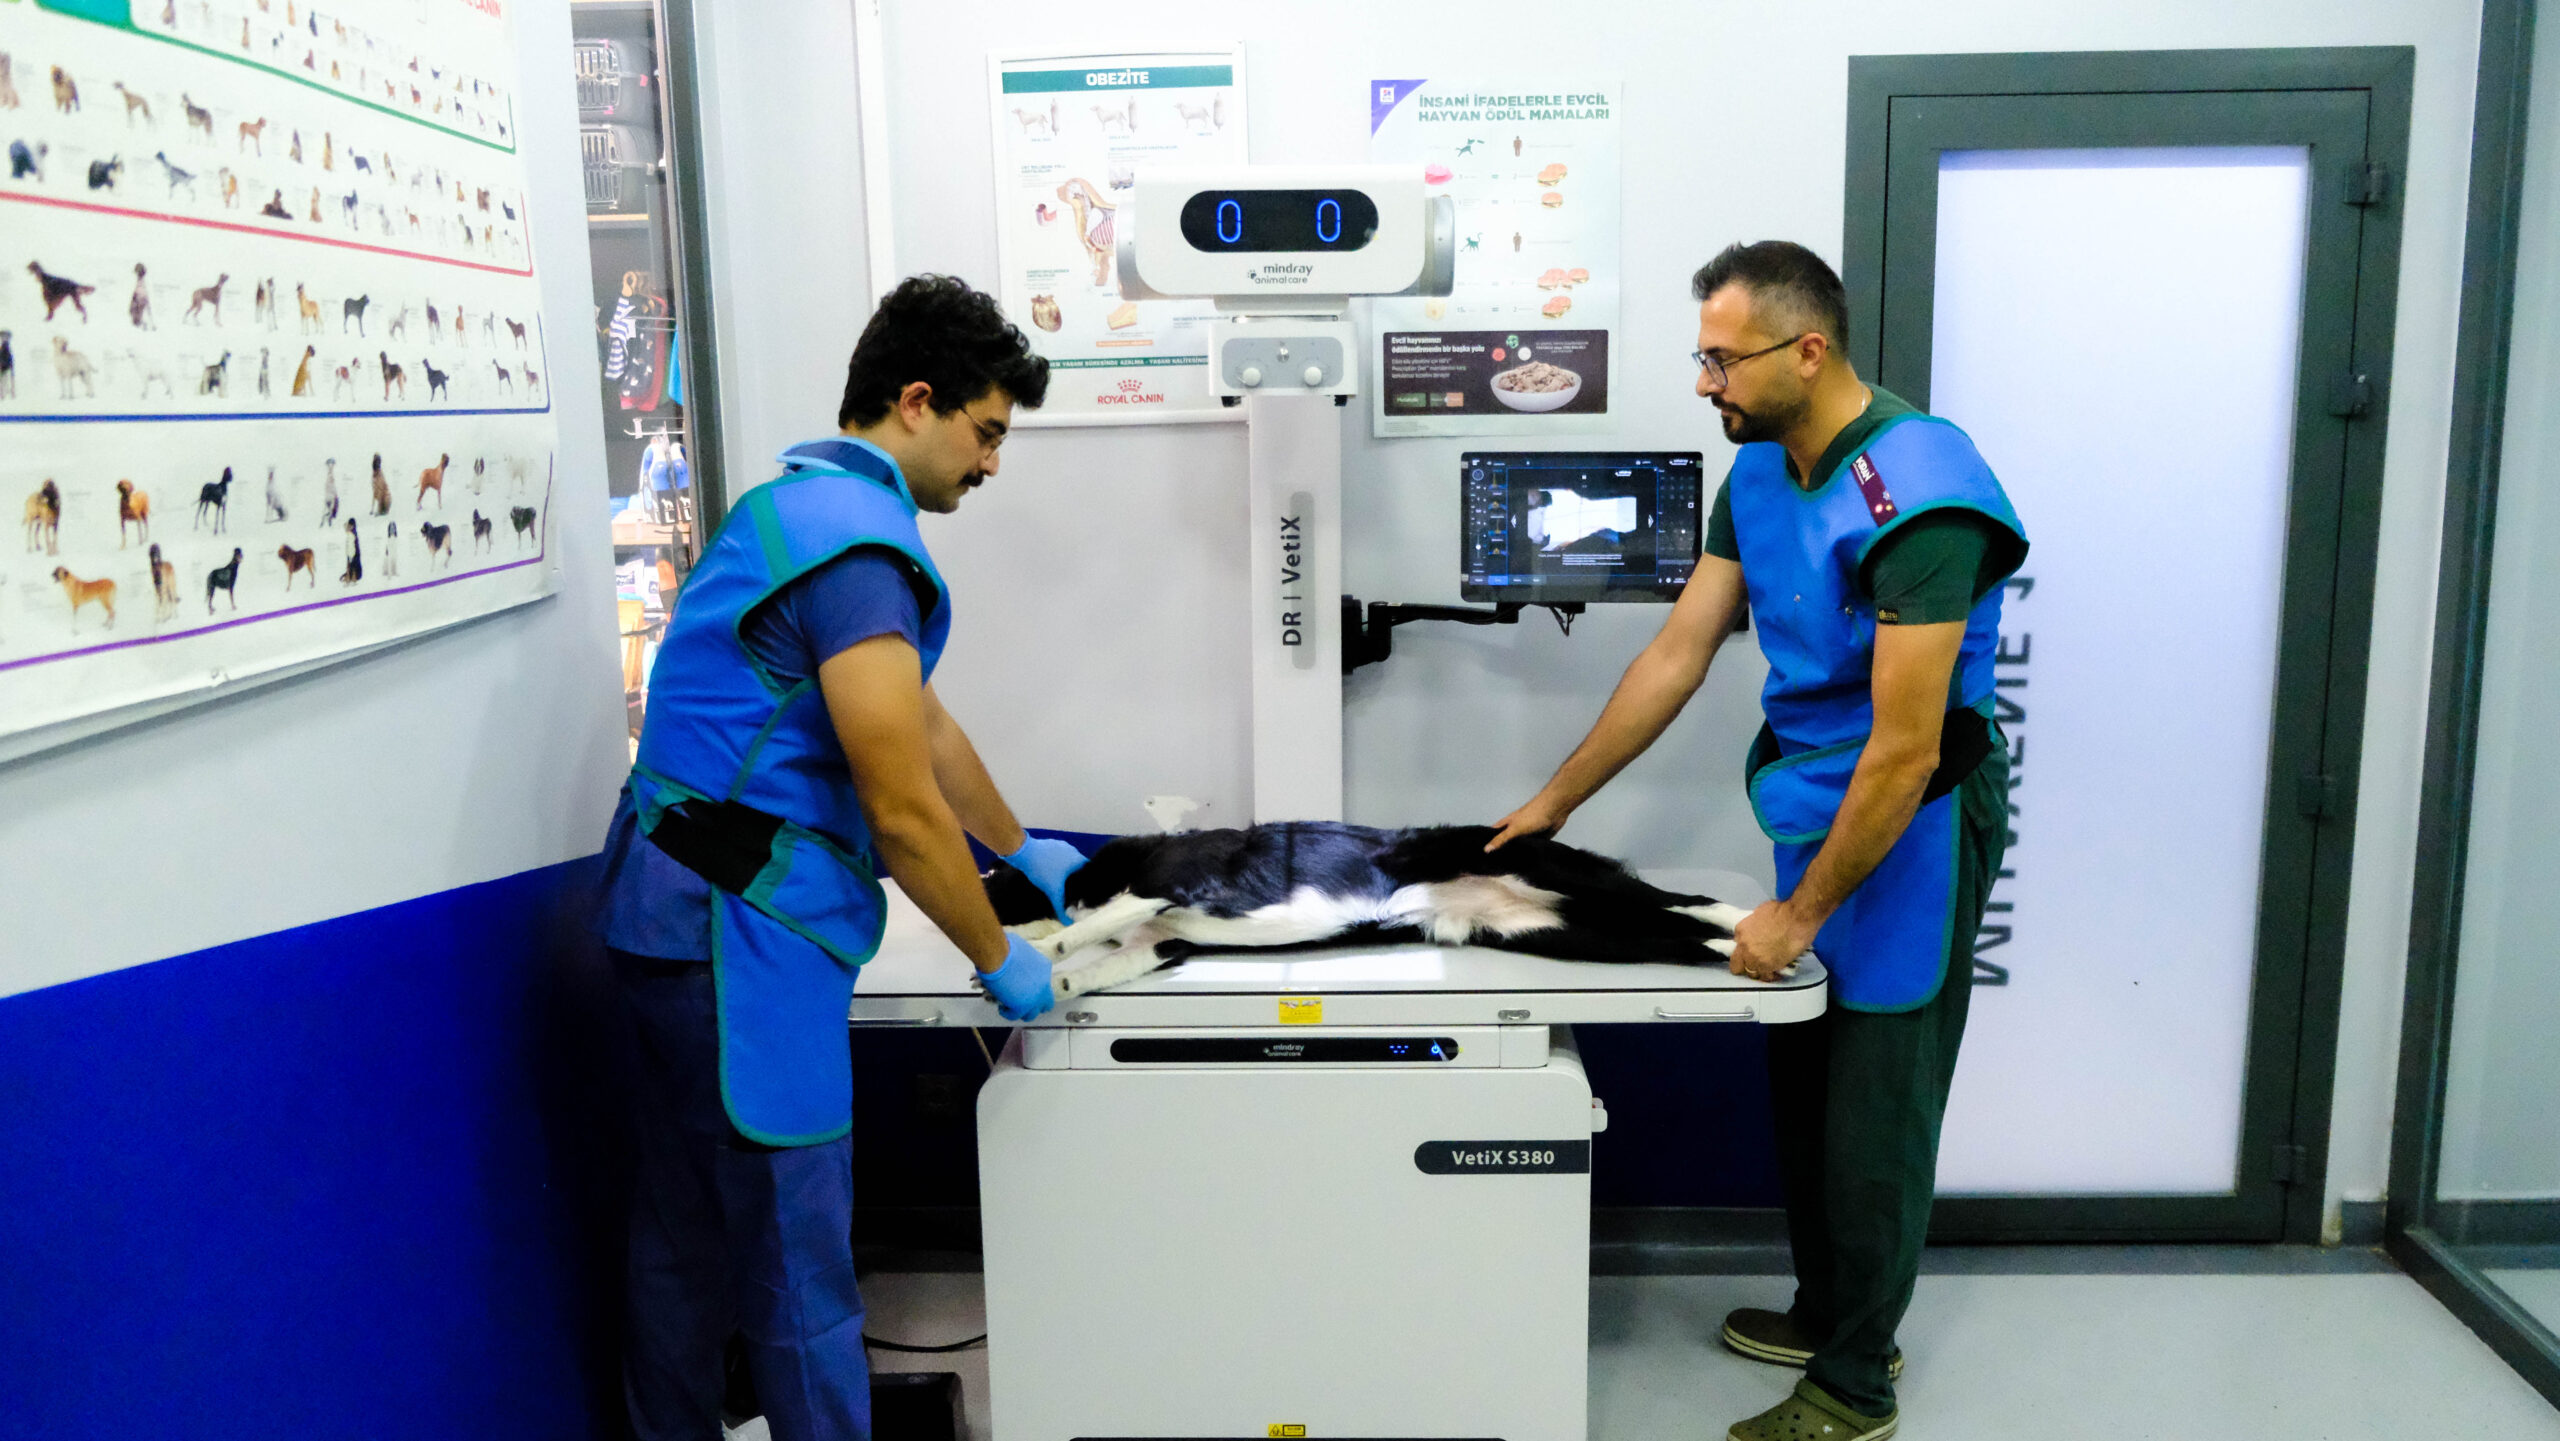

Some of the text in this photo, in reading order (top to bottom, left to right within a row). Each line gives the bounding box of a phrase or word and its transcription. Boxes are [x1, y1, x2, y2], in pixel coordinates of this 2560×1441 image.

[1085, 68, 1150, 86] OBEZİTE
[1419, 92, 1609, 108] İNSANİ İFADELERLE EVCİL
[1419, 107, 1610, 122] HAYVAN ÖDÜL MAMALARI
[1216, 199, 1242, 243] 0
[1316, 198, 1342, 243] 0
[1263, 264, 1314, 276] mindray
[1097, 392, 1164, 405] ROYAL CANIN
[1280, 516, 1301, 585] VetiX
[1282, 611, 1302, 646] DR
[1272, 1043, 1305, 1053] mindray
[1452, 1150, 1555, 1165] VetiX S380
